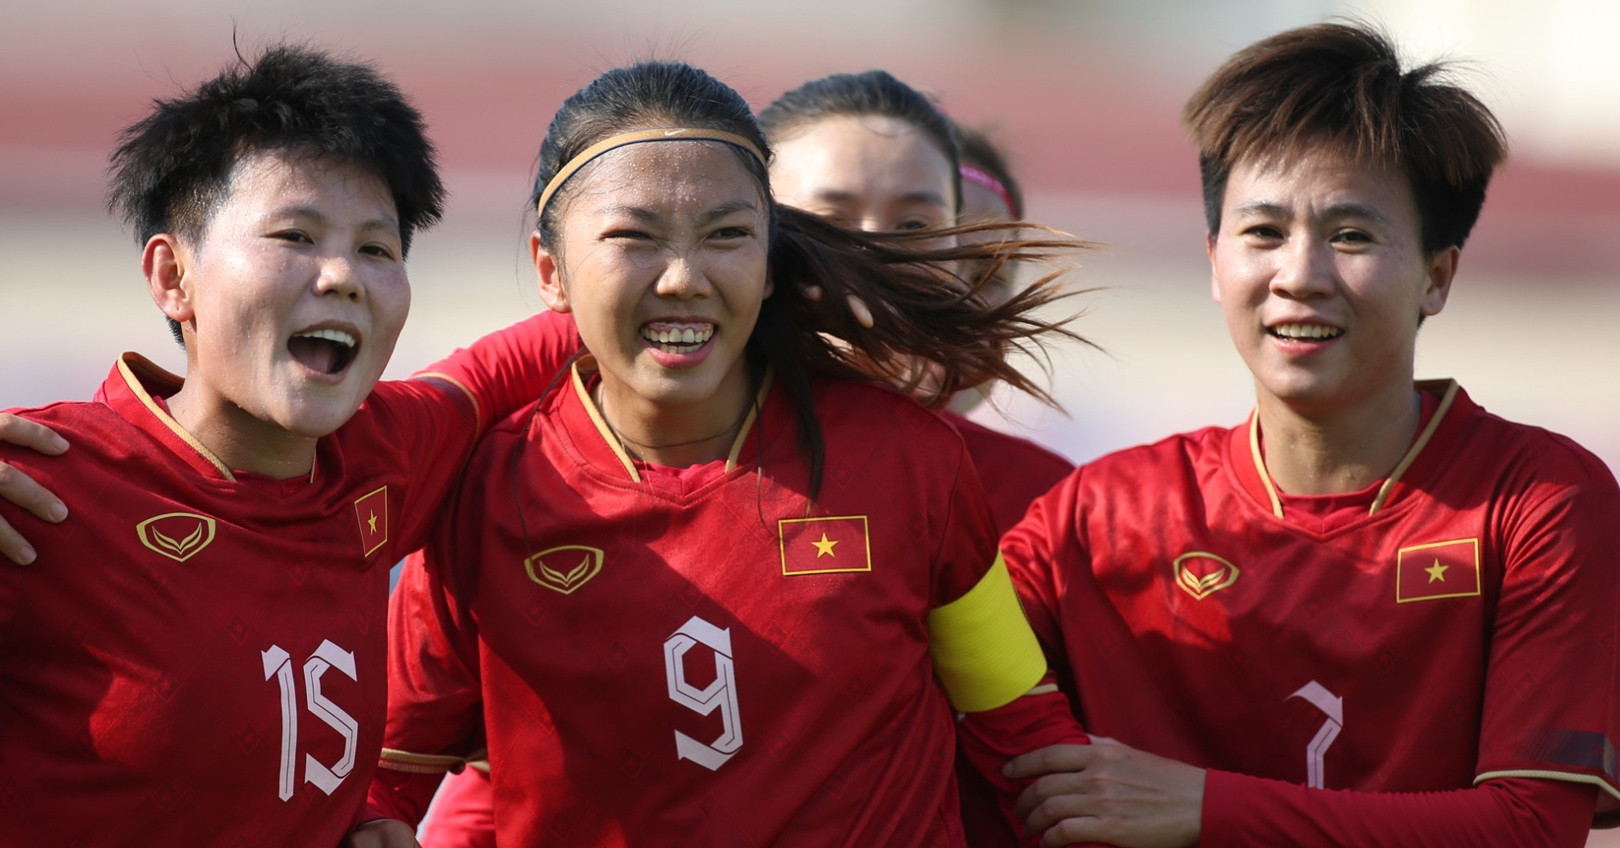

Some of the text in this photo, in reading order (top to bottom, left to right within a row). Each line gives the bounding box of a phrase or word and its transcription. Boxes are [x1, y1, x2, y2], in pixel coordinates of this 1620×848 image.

[261, 639, 359, 802] 15
[664, 615, 744, 771] 9
[1282, 679, 1343, 790] 7
